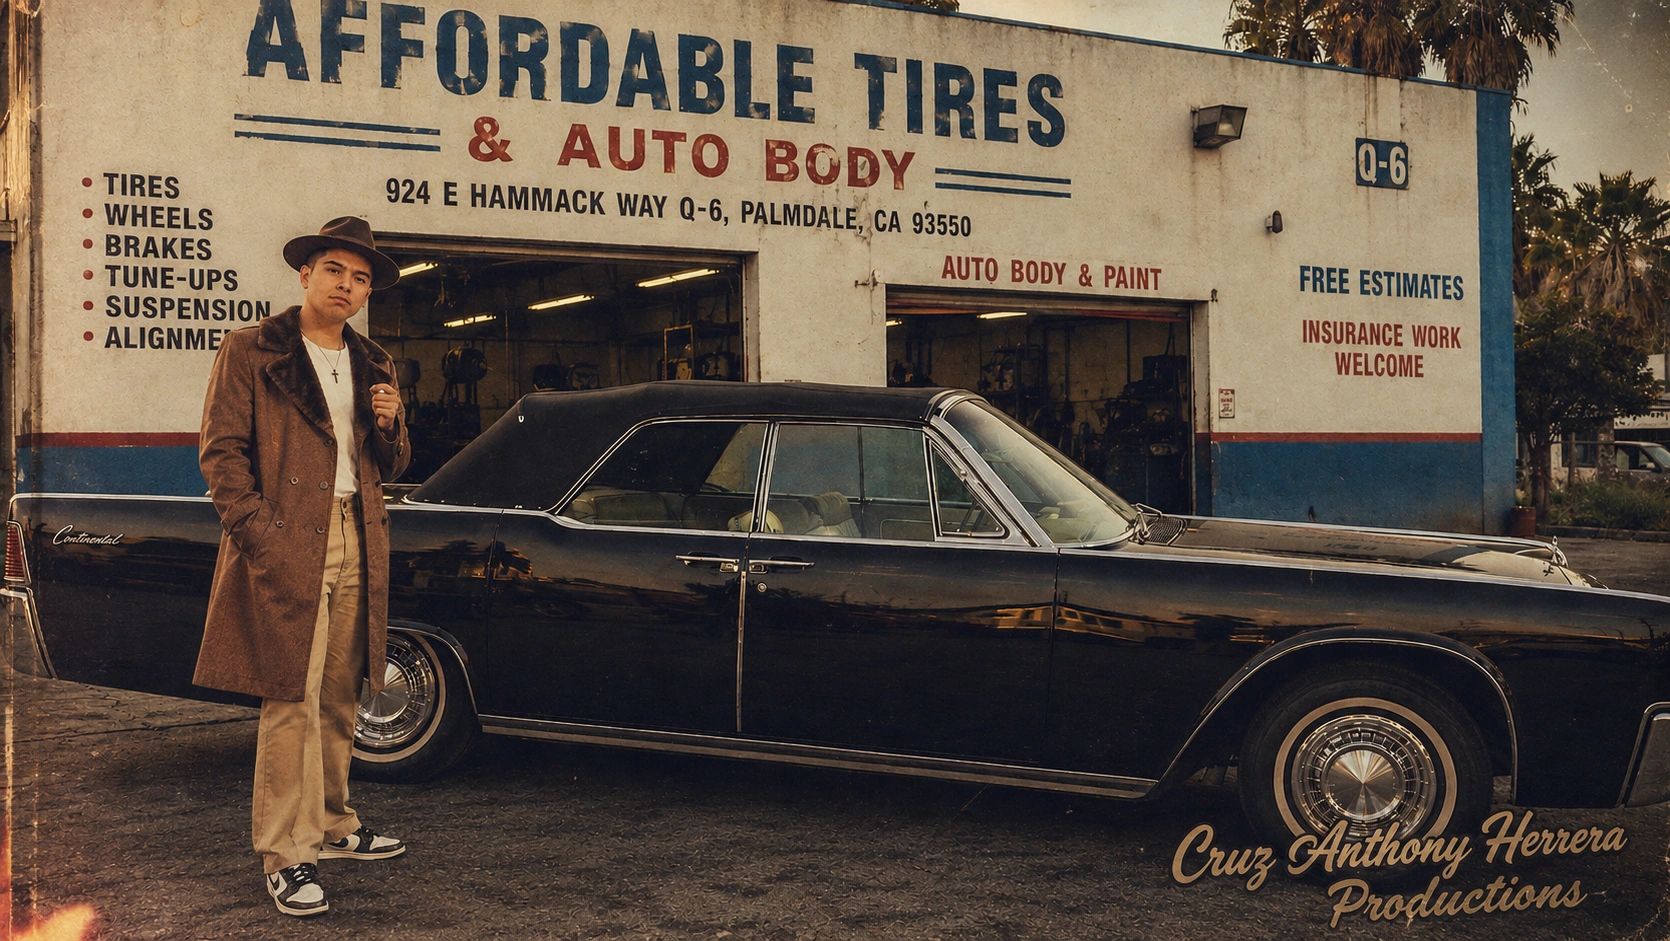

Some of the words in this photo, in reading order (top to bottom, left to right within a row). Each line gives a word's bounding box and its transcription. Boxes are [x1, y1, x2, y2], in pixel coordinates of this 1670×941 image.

[242, 0, 815, 124] AFFORDABLE
[854, 53, 1065, 148] TIRES
[468, 117, 513, 162] &
[558, 124, 729, 178] AUTO
[766, 139, 915, 190] BODY
[1358, 142, 1407, 185] Q-6
[103, 173, 179, 199] TIRES
[105, 203, 213, 230] WHEELS
[386, 178, 430, 204] 924
[444, 182, 457, 206] E
[471, 183, 605, 215] HAMMACK
[617, 193, 667, 218] WAY
[680, 197, 728, 226] Q-6,
[742, 201, 863, 233] PALMDALE,
[875, 210, 901, 232] CA
[913, 212, 971, 237] 93550
[106, 234, 211, 260] BRAKES
[105, 265, 238, 291] TUNE-UPS
[942, 256, 998, 285] AUTO
[1012, 260, 1066, 285] BODY
[1079, 264, 1092, 287] &
[1105, 265, 1161, 290] PAINT
[1300, 266, 1349, 294] FREE
[1360, 270, 1463, 300] ESTIMATES
[105, 295, 271, 322] SUSPENSION
[104, 326, 232, 351] ALIGNME
[1303, 320, 1403, 346] INSURANCE
[1412, 325, 1461, 348] WORK
[1335, 352, 1424, 377] WELCOME
[53, 524, 123, 544] Continental
